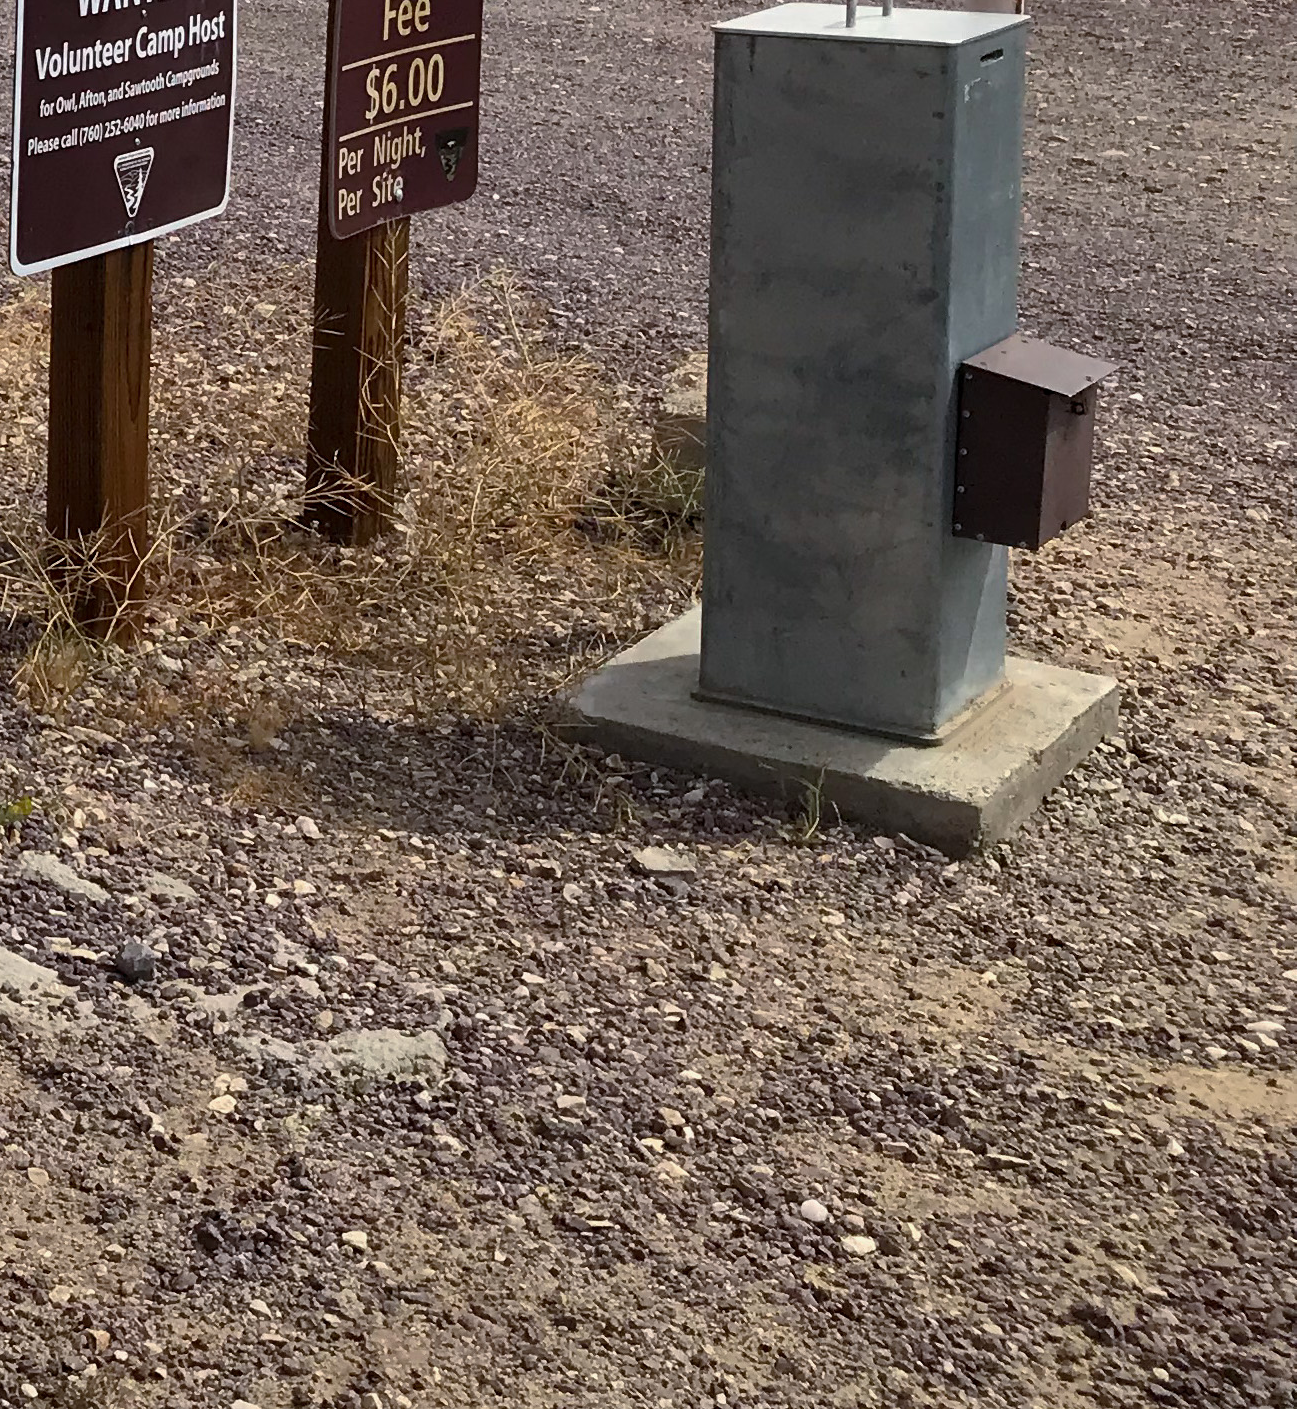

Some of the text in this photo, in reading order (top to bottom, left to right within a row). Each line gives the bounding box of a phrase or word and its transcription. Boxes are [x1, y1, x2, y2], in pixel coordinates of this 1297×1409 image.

[36, 11, 225, 79] Volunteer Camp Host
[40, 59, 219, 117] for Owl, Afton, and Sawtooth Campgrounds
[366, 54, 444, 124] $6.00
[28, 92, 225, 155] Please call (760) 252-6040 for more information
[339, 126, 426, 179] Per Night,
[339, 172, 403, 220] Per Site
